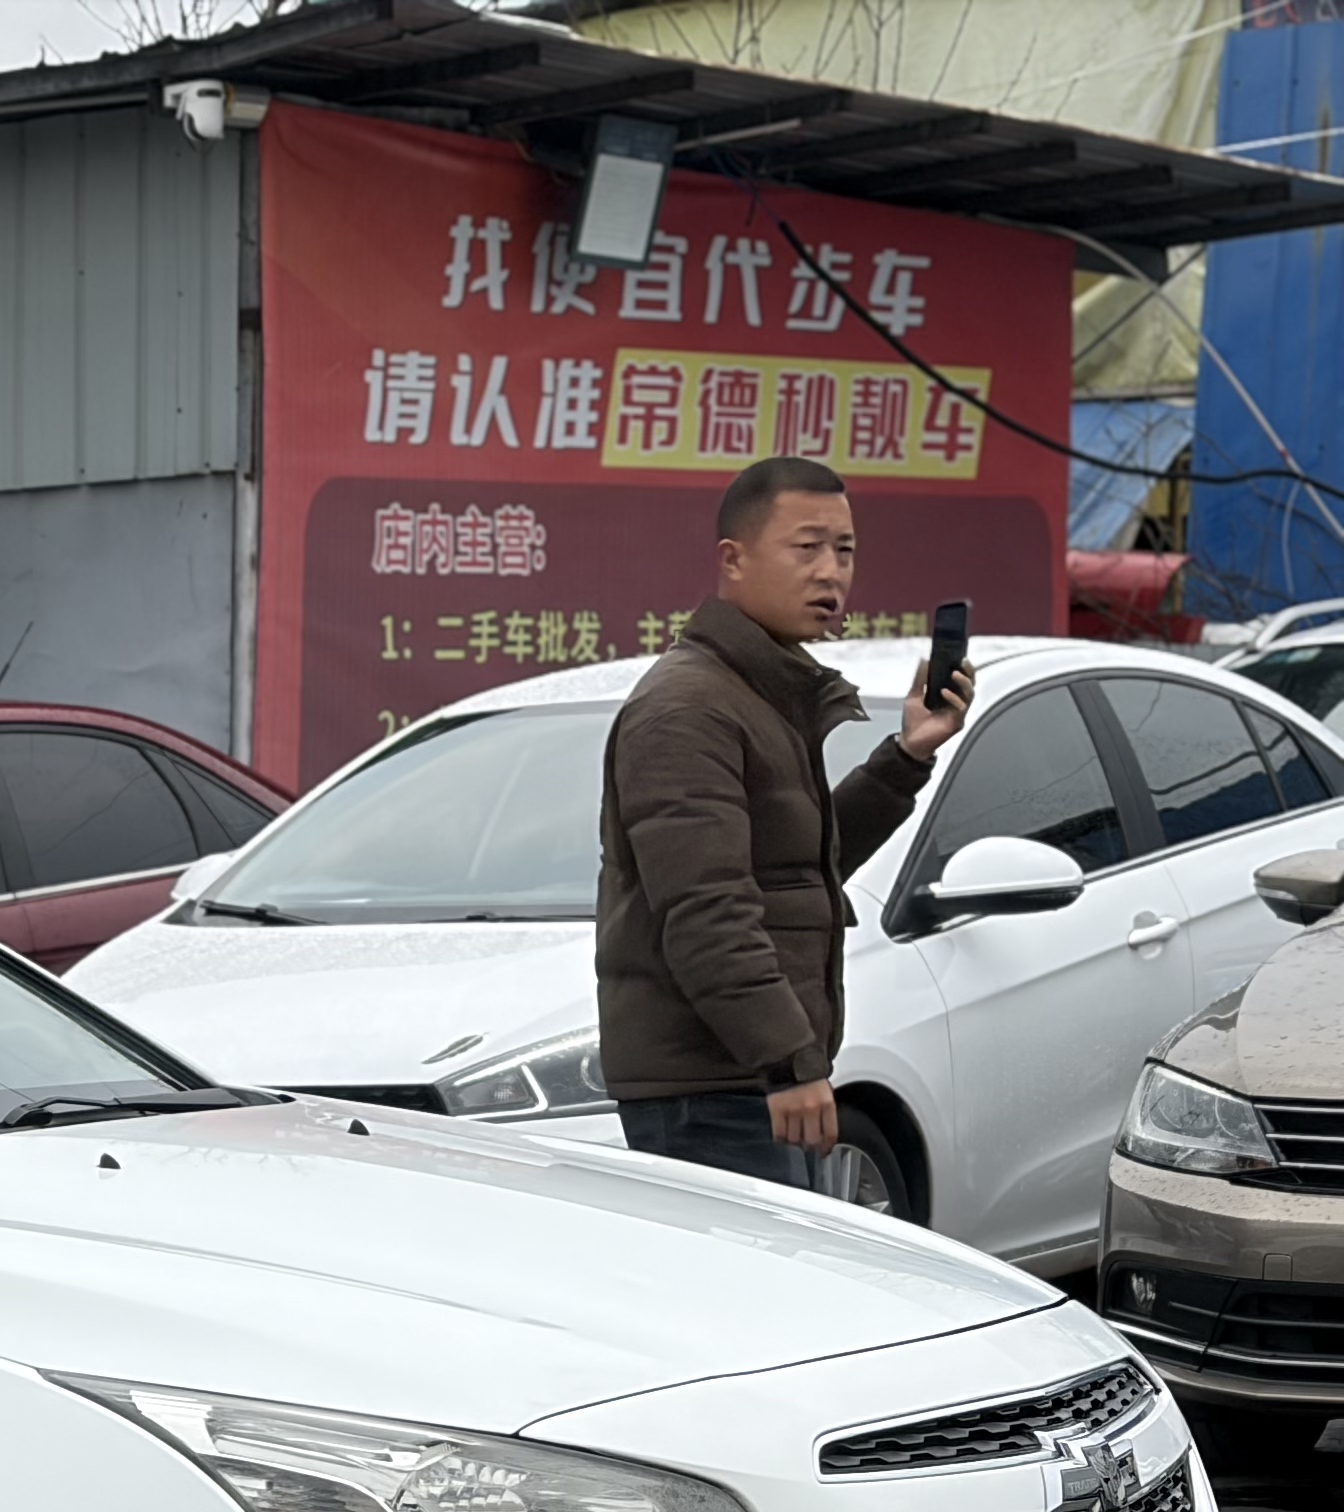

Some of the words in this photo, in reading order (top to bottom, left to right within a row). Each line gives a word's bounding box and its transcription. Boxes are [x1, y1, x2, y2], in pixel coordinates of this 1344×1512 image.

[442, 214, 931, 337] 找便宜代步车
[364, 349, 981, 463] 请认准常德秒靓车
